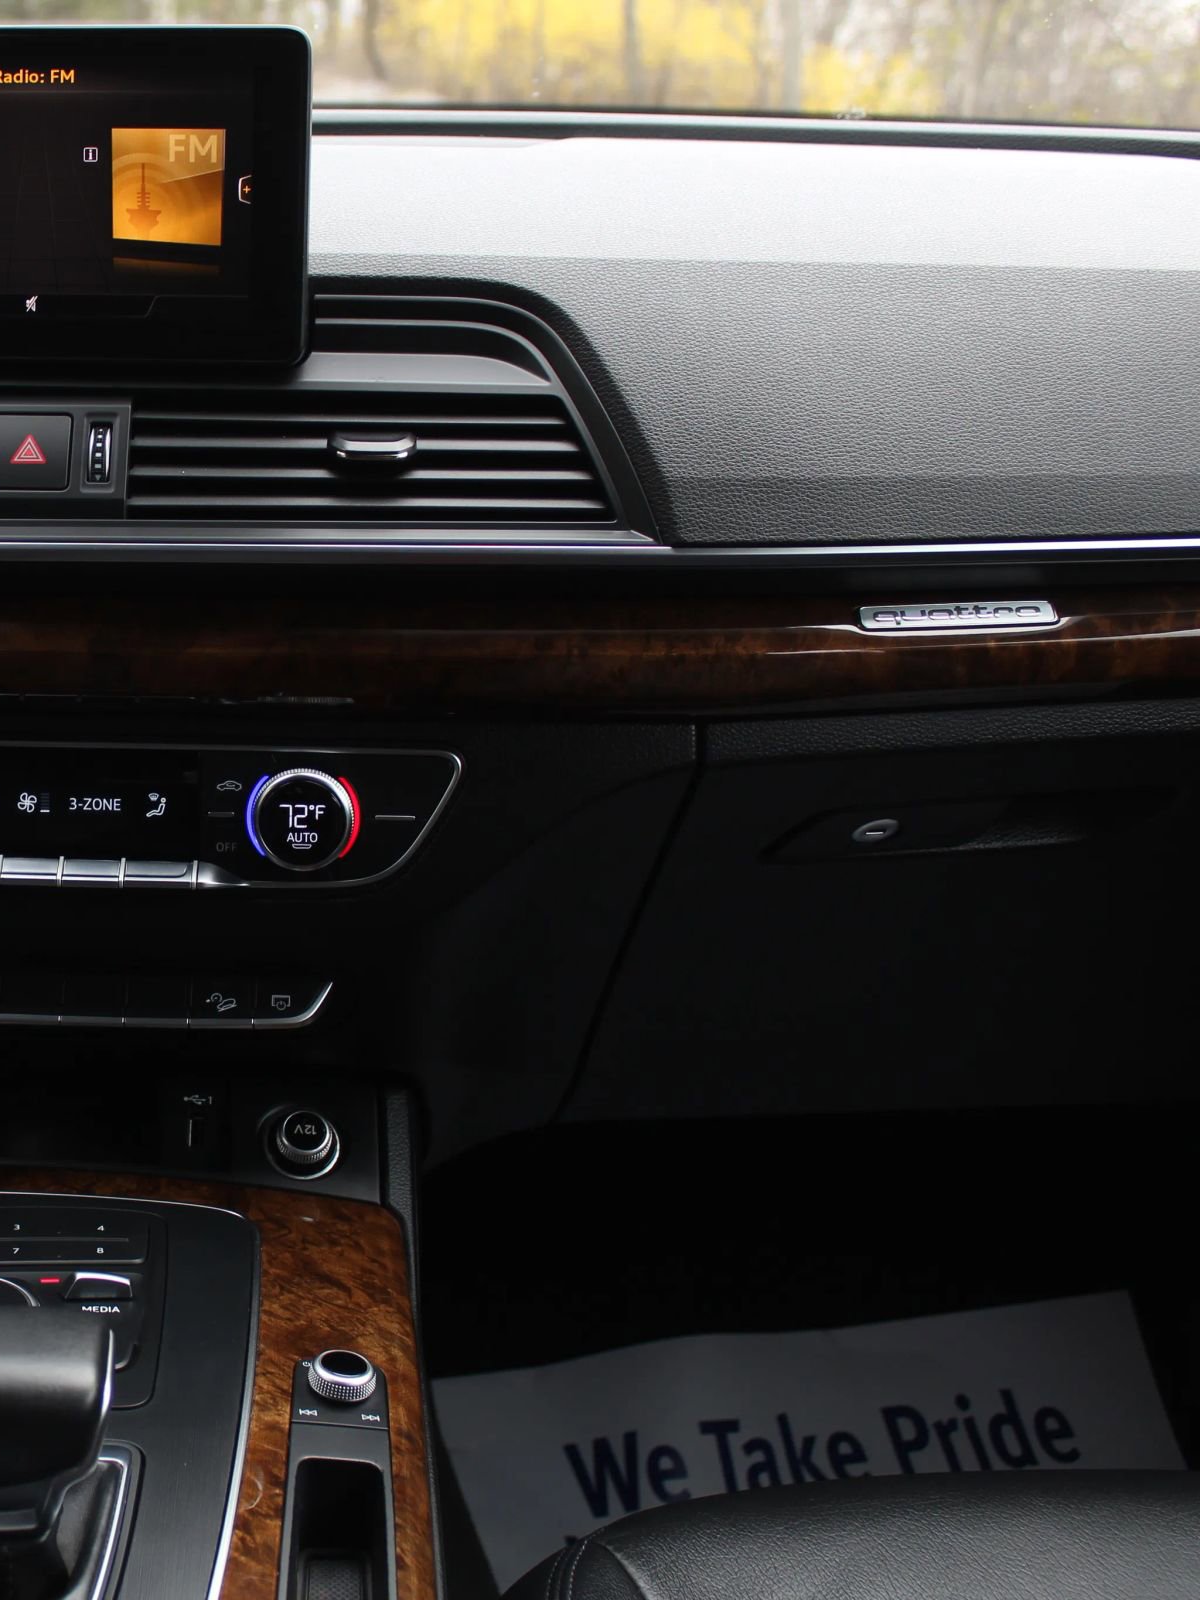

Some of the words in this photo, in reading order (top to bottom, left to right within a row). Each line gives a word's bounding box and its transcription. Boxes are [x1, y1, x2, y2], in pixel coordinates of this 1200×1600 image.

[50, 68, 75, 84] FM
[167, 133, 218, 163] FM
[872, 604, 1042, 626] quattro
[68, 797, 122, 811] 3-ZONE
[286, 831, 318, 843] AUTO
[215, 841, 237, 853] OFF
[293, 1124, 318, 1136] 12V
[13, 1223, 21, 1231] 3
[12, 1247, 20, 1255] 7
[81, 1305, 121, 1314] MEDIA
[563, 1431, 692, 1518] We
[700, 1413, 870, 1495] Take
[881, 1389, 1081, 1475] Pride
